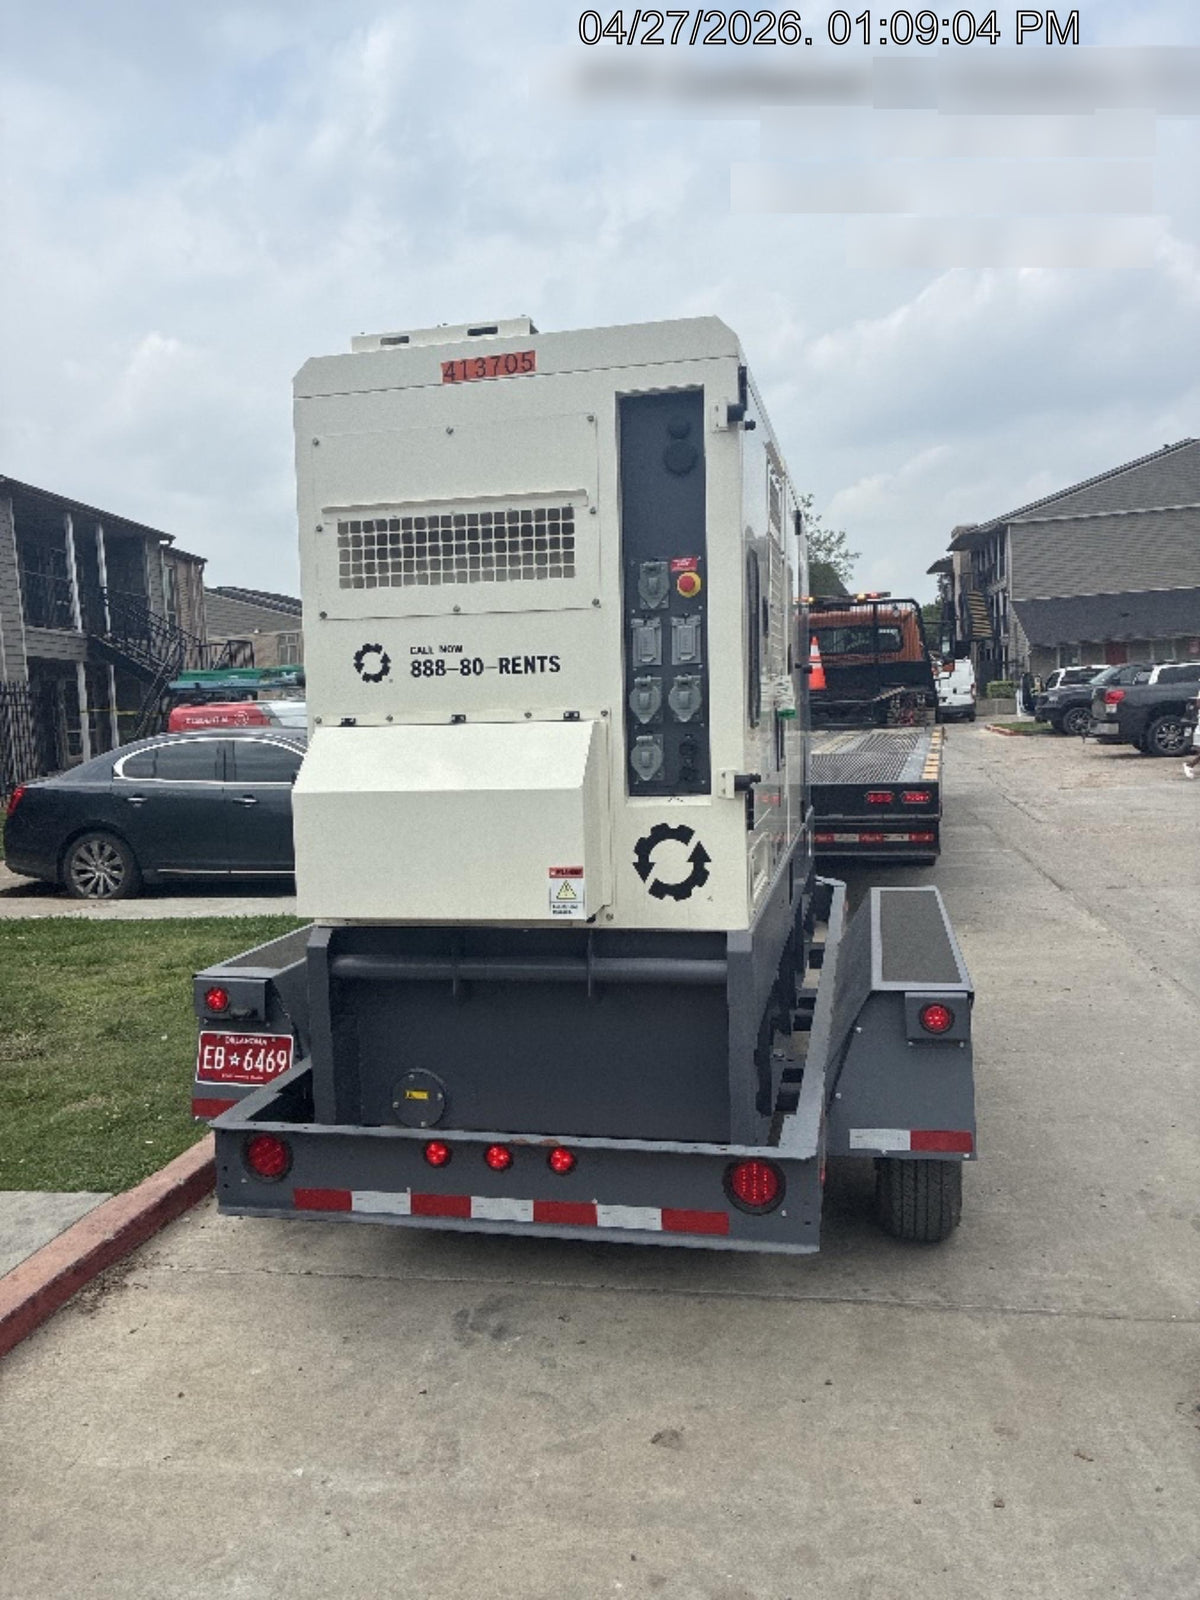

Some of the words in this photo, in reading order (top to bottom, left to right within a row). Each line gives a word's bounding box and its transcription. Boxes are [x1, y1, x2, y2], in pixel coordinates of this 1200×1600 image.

[443, 351, 533, 381] 413705
[410, 646, 434, 655] CALL
[439, 644, 463, 653] NOW
[410, 655, 561, 678] 888-80-RENTS
[243, 1048, 287, 1072] 6469
